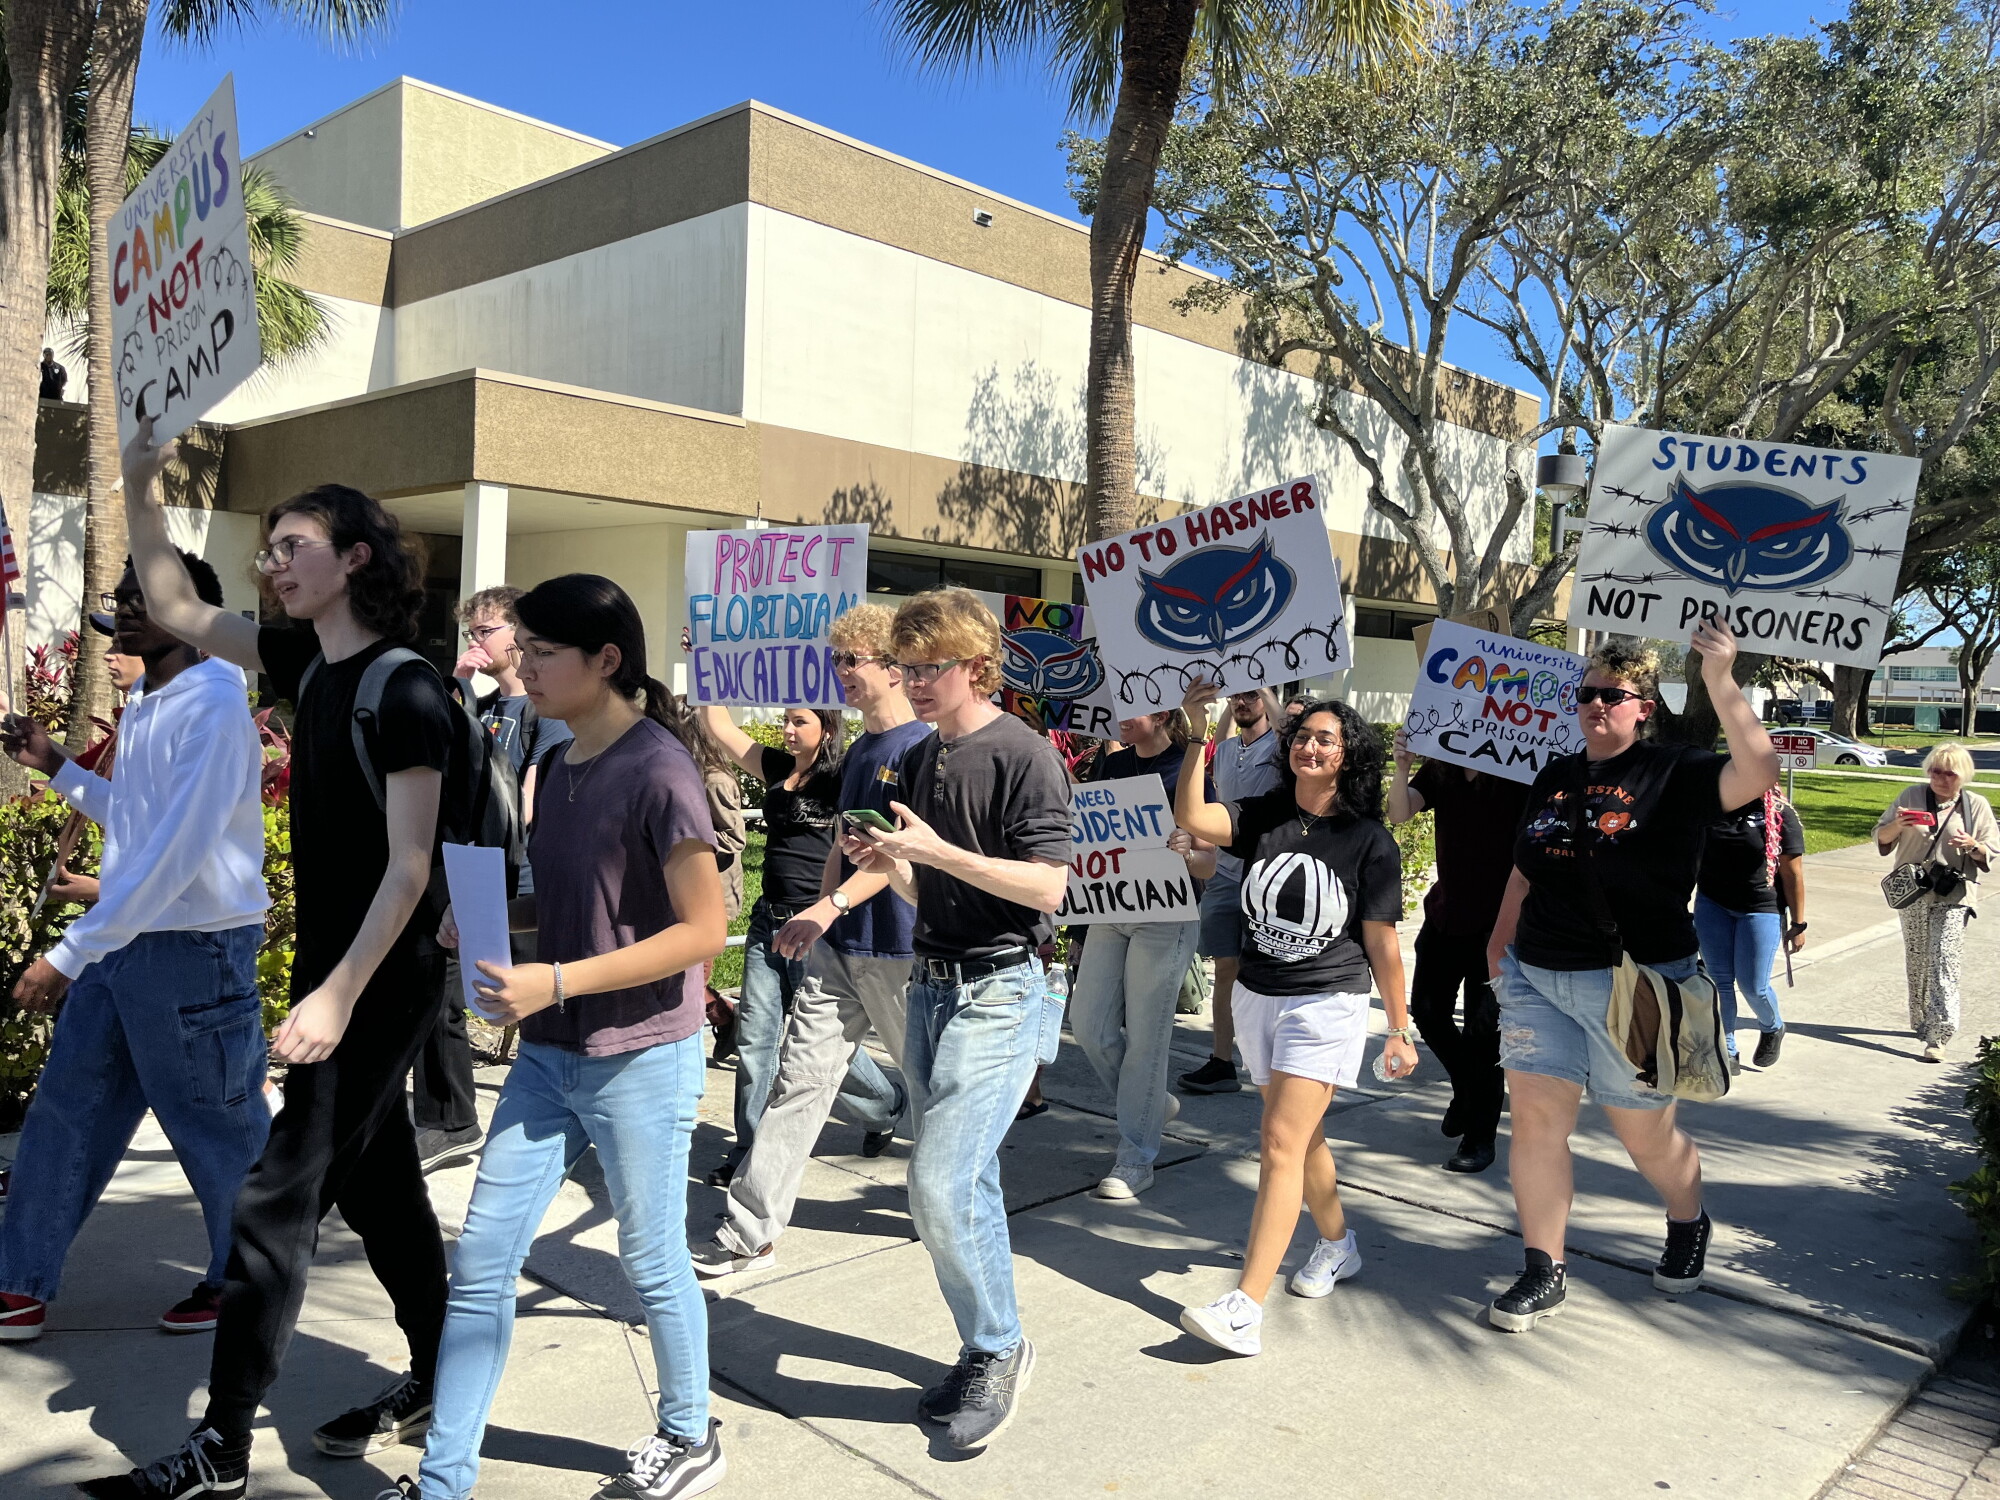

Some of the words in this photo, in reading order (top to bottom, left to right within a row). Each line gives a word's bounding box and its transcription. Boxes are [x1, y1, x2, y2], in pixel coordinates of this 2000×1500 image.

[124, 109, 215, 231] UNIVERSITY
[114, 131, 229, 306] CAMPUS
[149, 237, 203, 335] NOT
[155, 291, 206, 366] PRISON
[135, 309, 234, 423] CAMP
[1652, 436, 1868, 485] STUDENTS
[1082, 542, 1125, 583] NO
[1129, 527, 1178, 562] TO
[1185, 482, 1316, 546] HASNER
[714, 533, 855, 596] PROTECT
[1008, 600, 1074, 629] NO
[1587, 584, 1662, 623] NOT
[1679, 596, 1870, 651] PRISONERS
[694, 645, 846, 705] EDUCATION
[1427, 648, 1578, 715] CAMPU
[989, 689, 1112, 736] ASNER
[1472, 719, 1547, 747] PRISON
[1481, 696, 1557, 732] NOT
[1071, 804, 1163, 843] SIDENT
[1074, 789, 1115, 810] NEED
[1067, 847, 1127, 881] NOT
[1055, 876, 1188, 917] LITICIAN
[1254, 932, 1321, 954] ORGANIZATION
